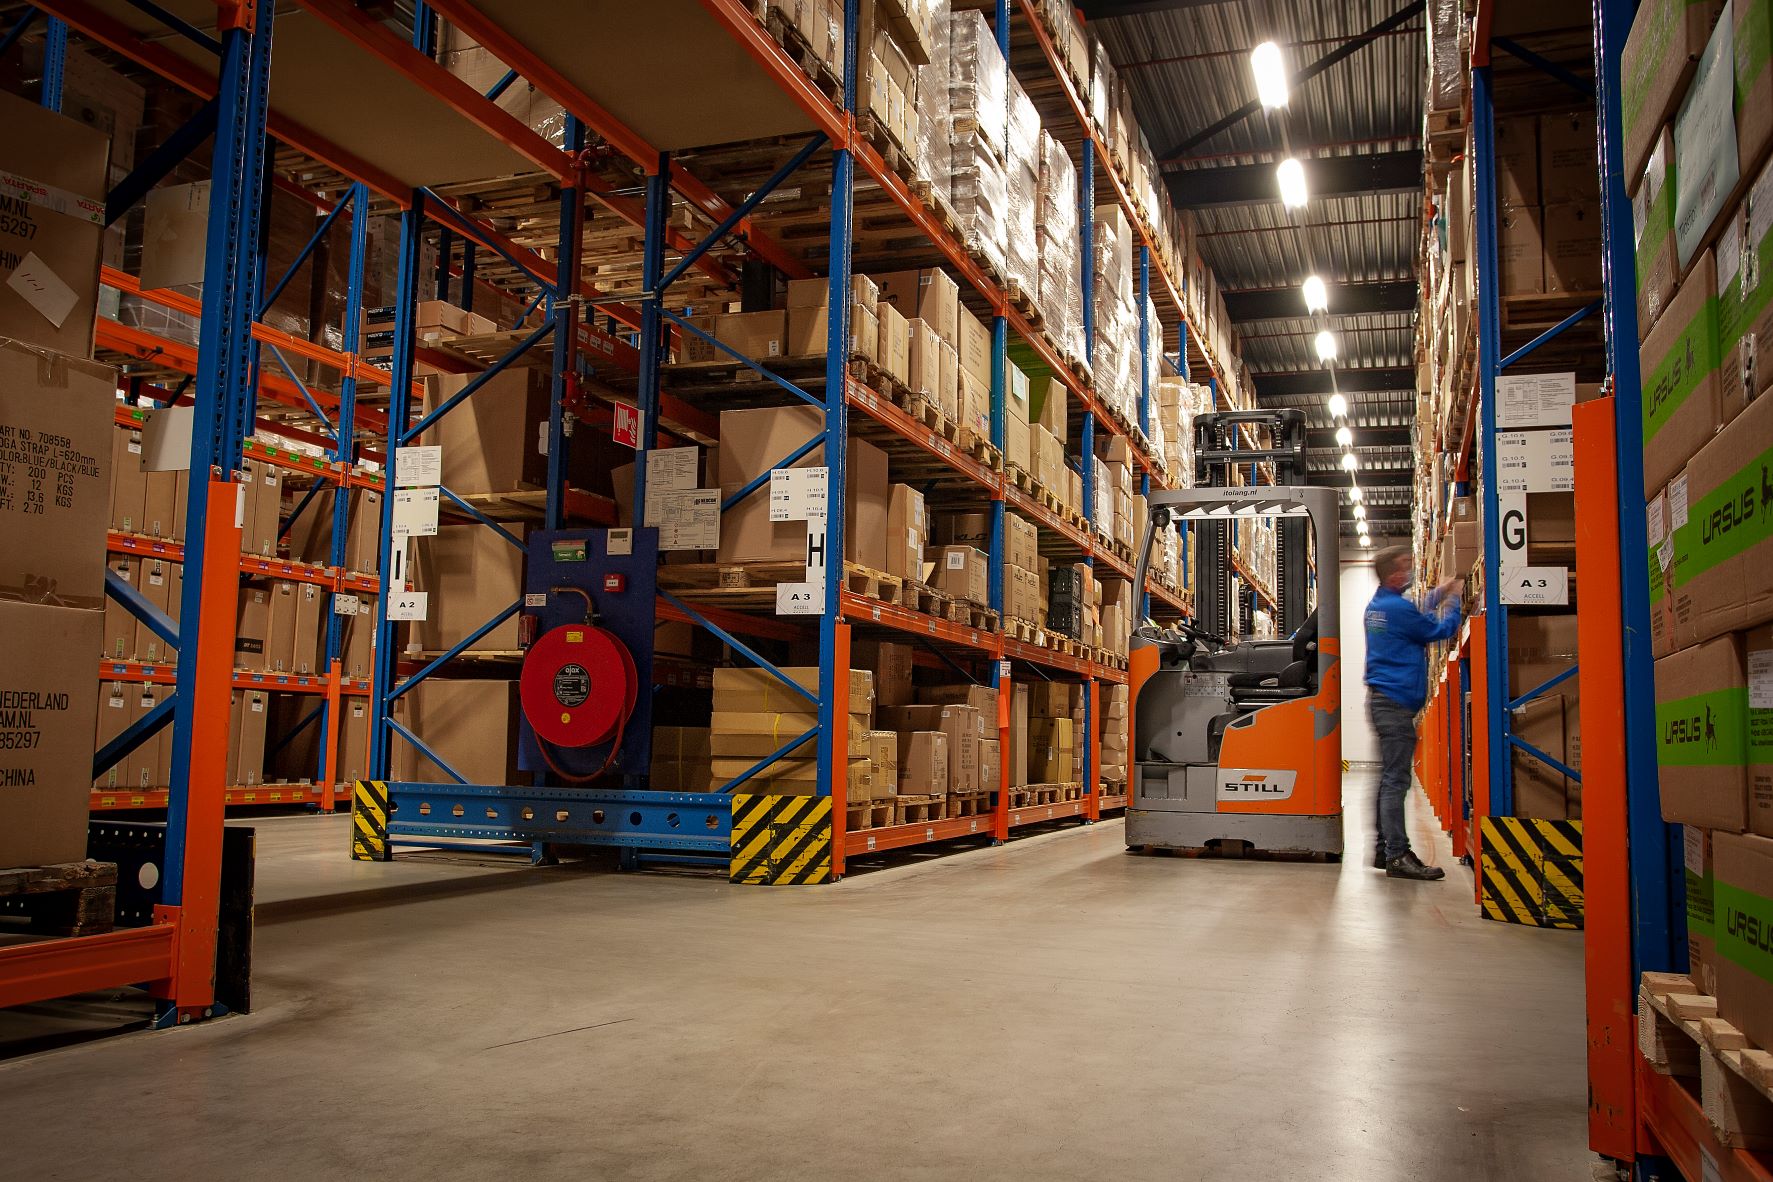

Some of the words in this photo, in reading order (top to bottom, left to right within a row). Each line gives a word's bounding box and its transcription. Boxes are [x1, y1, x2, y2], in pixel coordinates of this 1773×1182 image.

[0, 250, 22, 270] HIN
[1649, 357, 1681, 418] URSUS
[38, 432, 71, 449] 708558
[20, 441, 50, 456] STRAP
[53, 449, 96, 465] L=620mm
[28, 466, 46, 480] 200
[57, 472, 75, 485] PCS
[31, 479, 42, 491] 12
[56, 483, 74, 497] KGS
[1223, 489, 1258, 497] itolang.nl
[23, 501, 44, 515] 2.70
[27, 490, 44, 503] 13.6
[55, 495, 72, 508] KGS
[1702, 486, 1755, 545] URSUS
[1501, 509, 1525, 551] G
[808, 533, 825, 567] H
[1520, 579, 1532, 588] A
[1538, 579, 1547, 588] 3
[790, 593, 800, 601] A
[803, 593, 811, 601] 3
[565, 665, 580, 676] ajax
[1665, 716, 1701, 745] URSUS
[1225, 783, 1285, 793] STILL
[1727, 906, 1773, 955] URSU
